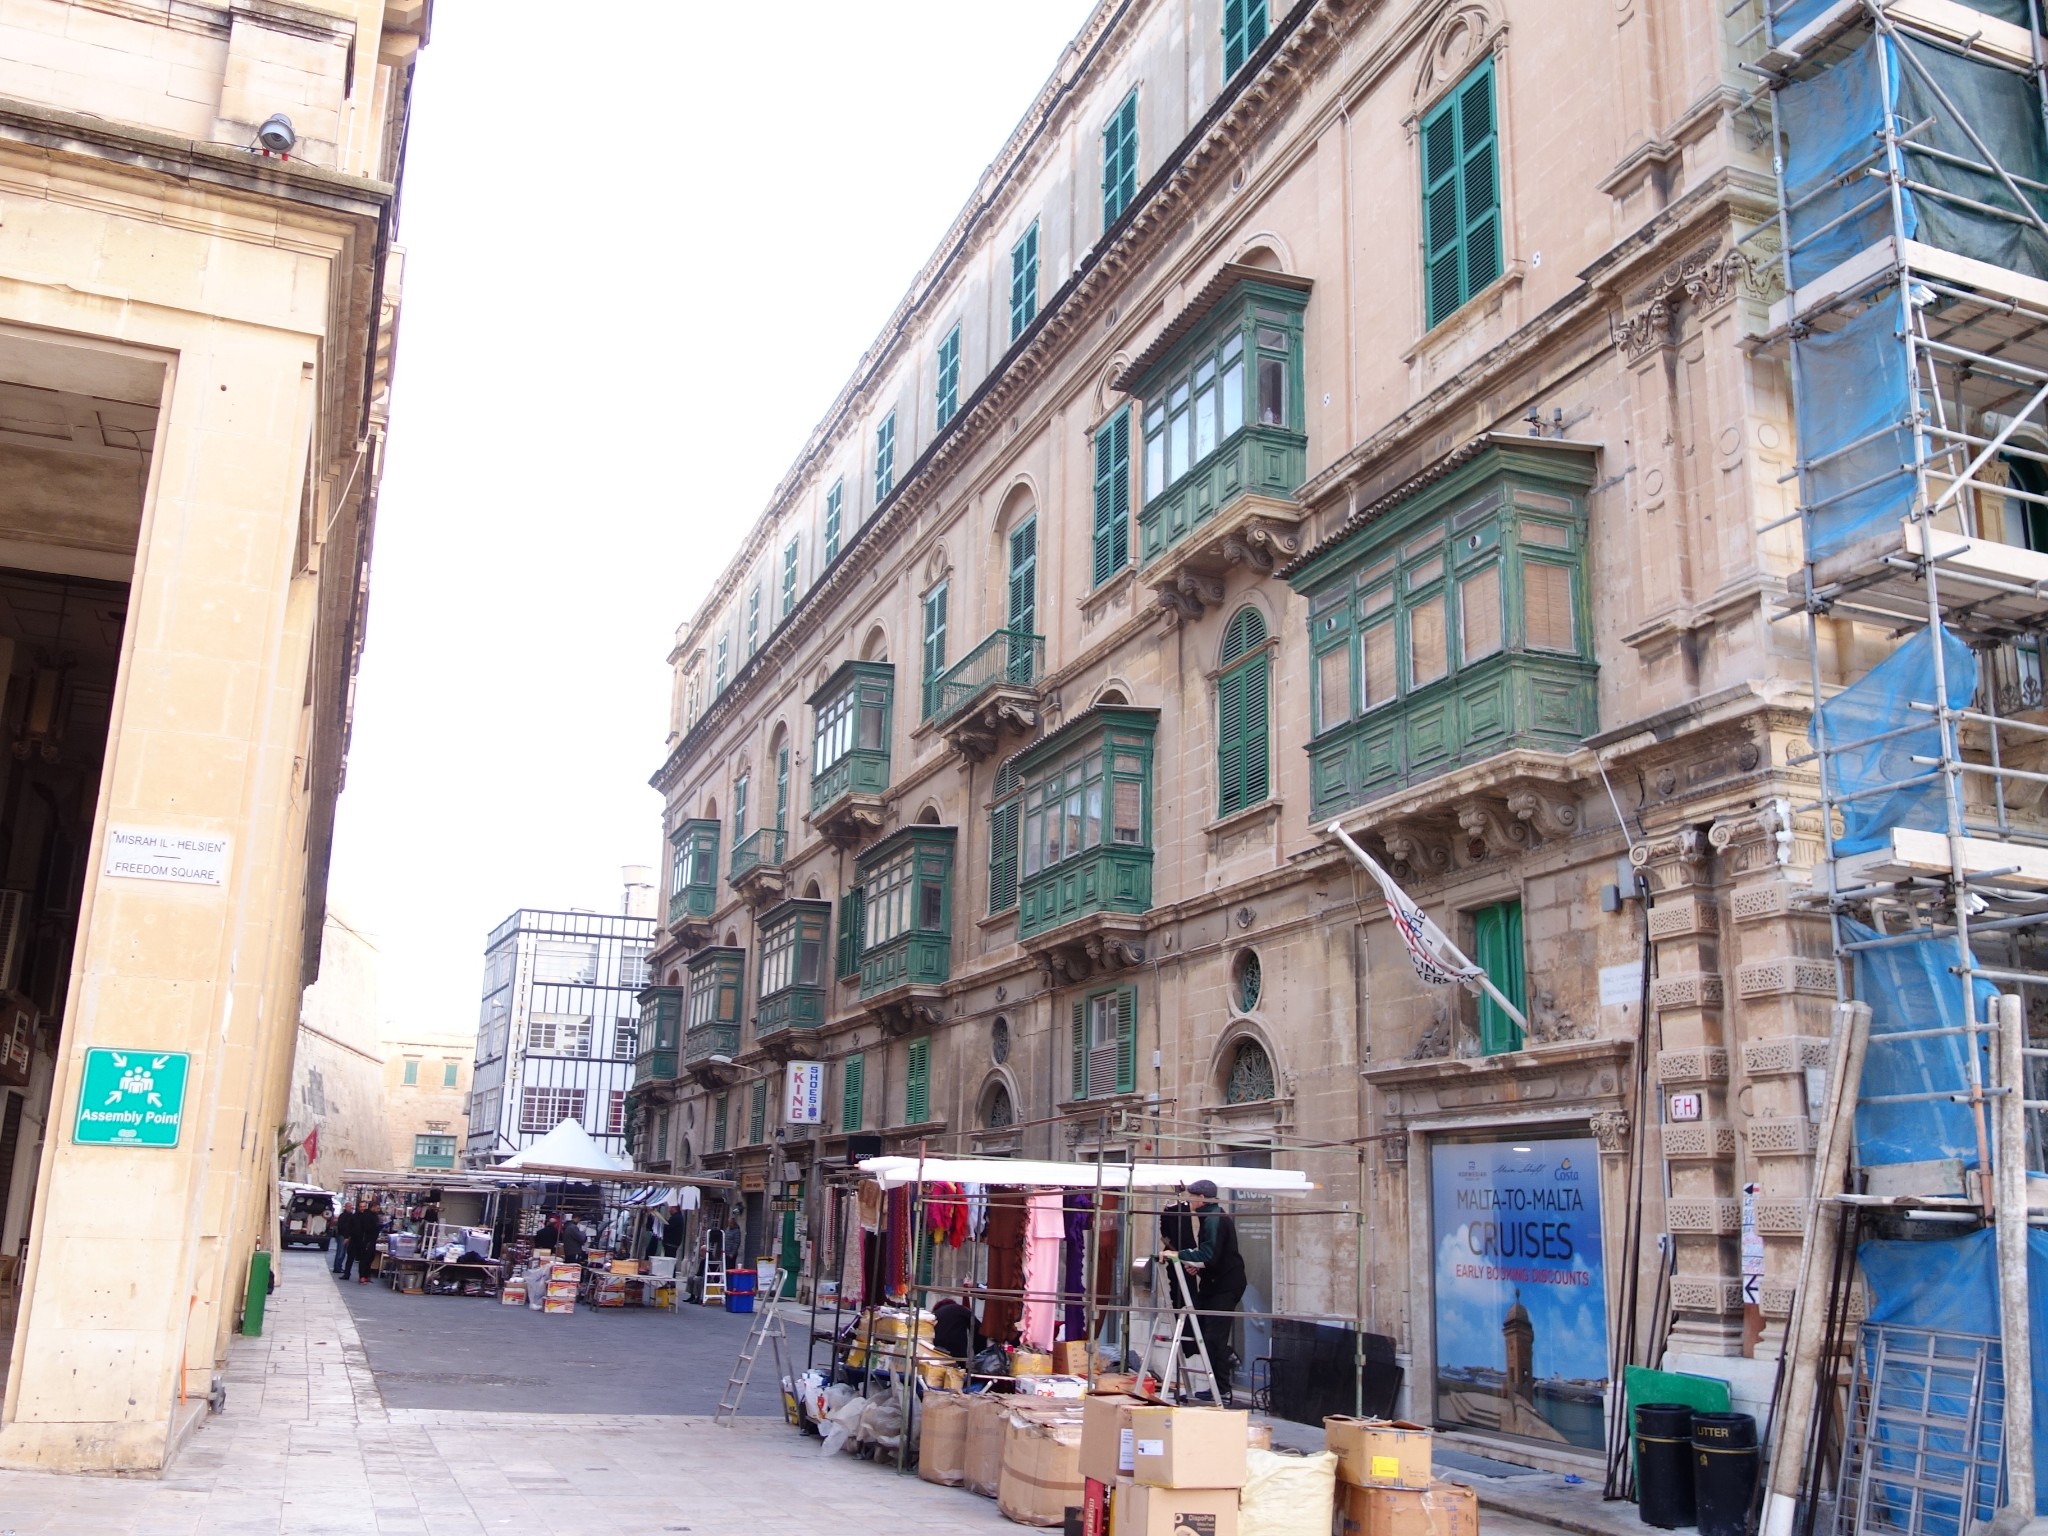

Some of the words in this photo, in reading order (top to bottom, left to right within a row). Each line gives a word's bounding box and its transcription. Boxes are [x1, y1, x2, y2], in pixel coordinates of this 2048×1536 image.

[160, 839, 168, 848] IL
[177, 840, 222, 853] HELSIEN
[115, 862, 168, 875] FREEDOM
[171, 866, 215, 880] SQUARE
[809, 1066, 818, 1104] SHOES
[792, 1072, 804, 1119] KING
[81, 1108, 143, 1126] Assembly
[145, 1111, 178, 1125] Point
[1554, 1167, 1579, 1181] Costa
[1457, 1188, 1583, 1211] MALTA-TO-MALTA
[1468, 1221, 1574, 1260] CRUISES
[1456, 1264, 1485, 1279] EARLY
[1487, 1266, 1529, 1282] BOOKING
[1531, 1268, 1590, 1286] DISCOUNTS
[1036, 1389, 1055, 1398] Dole
